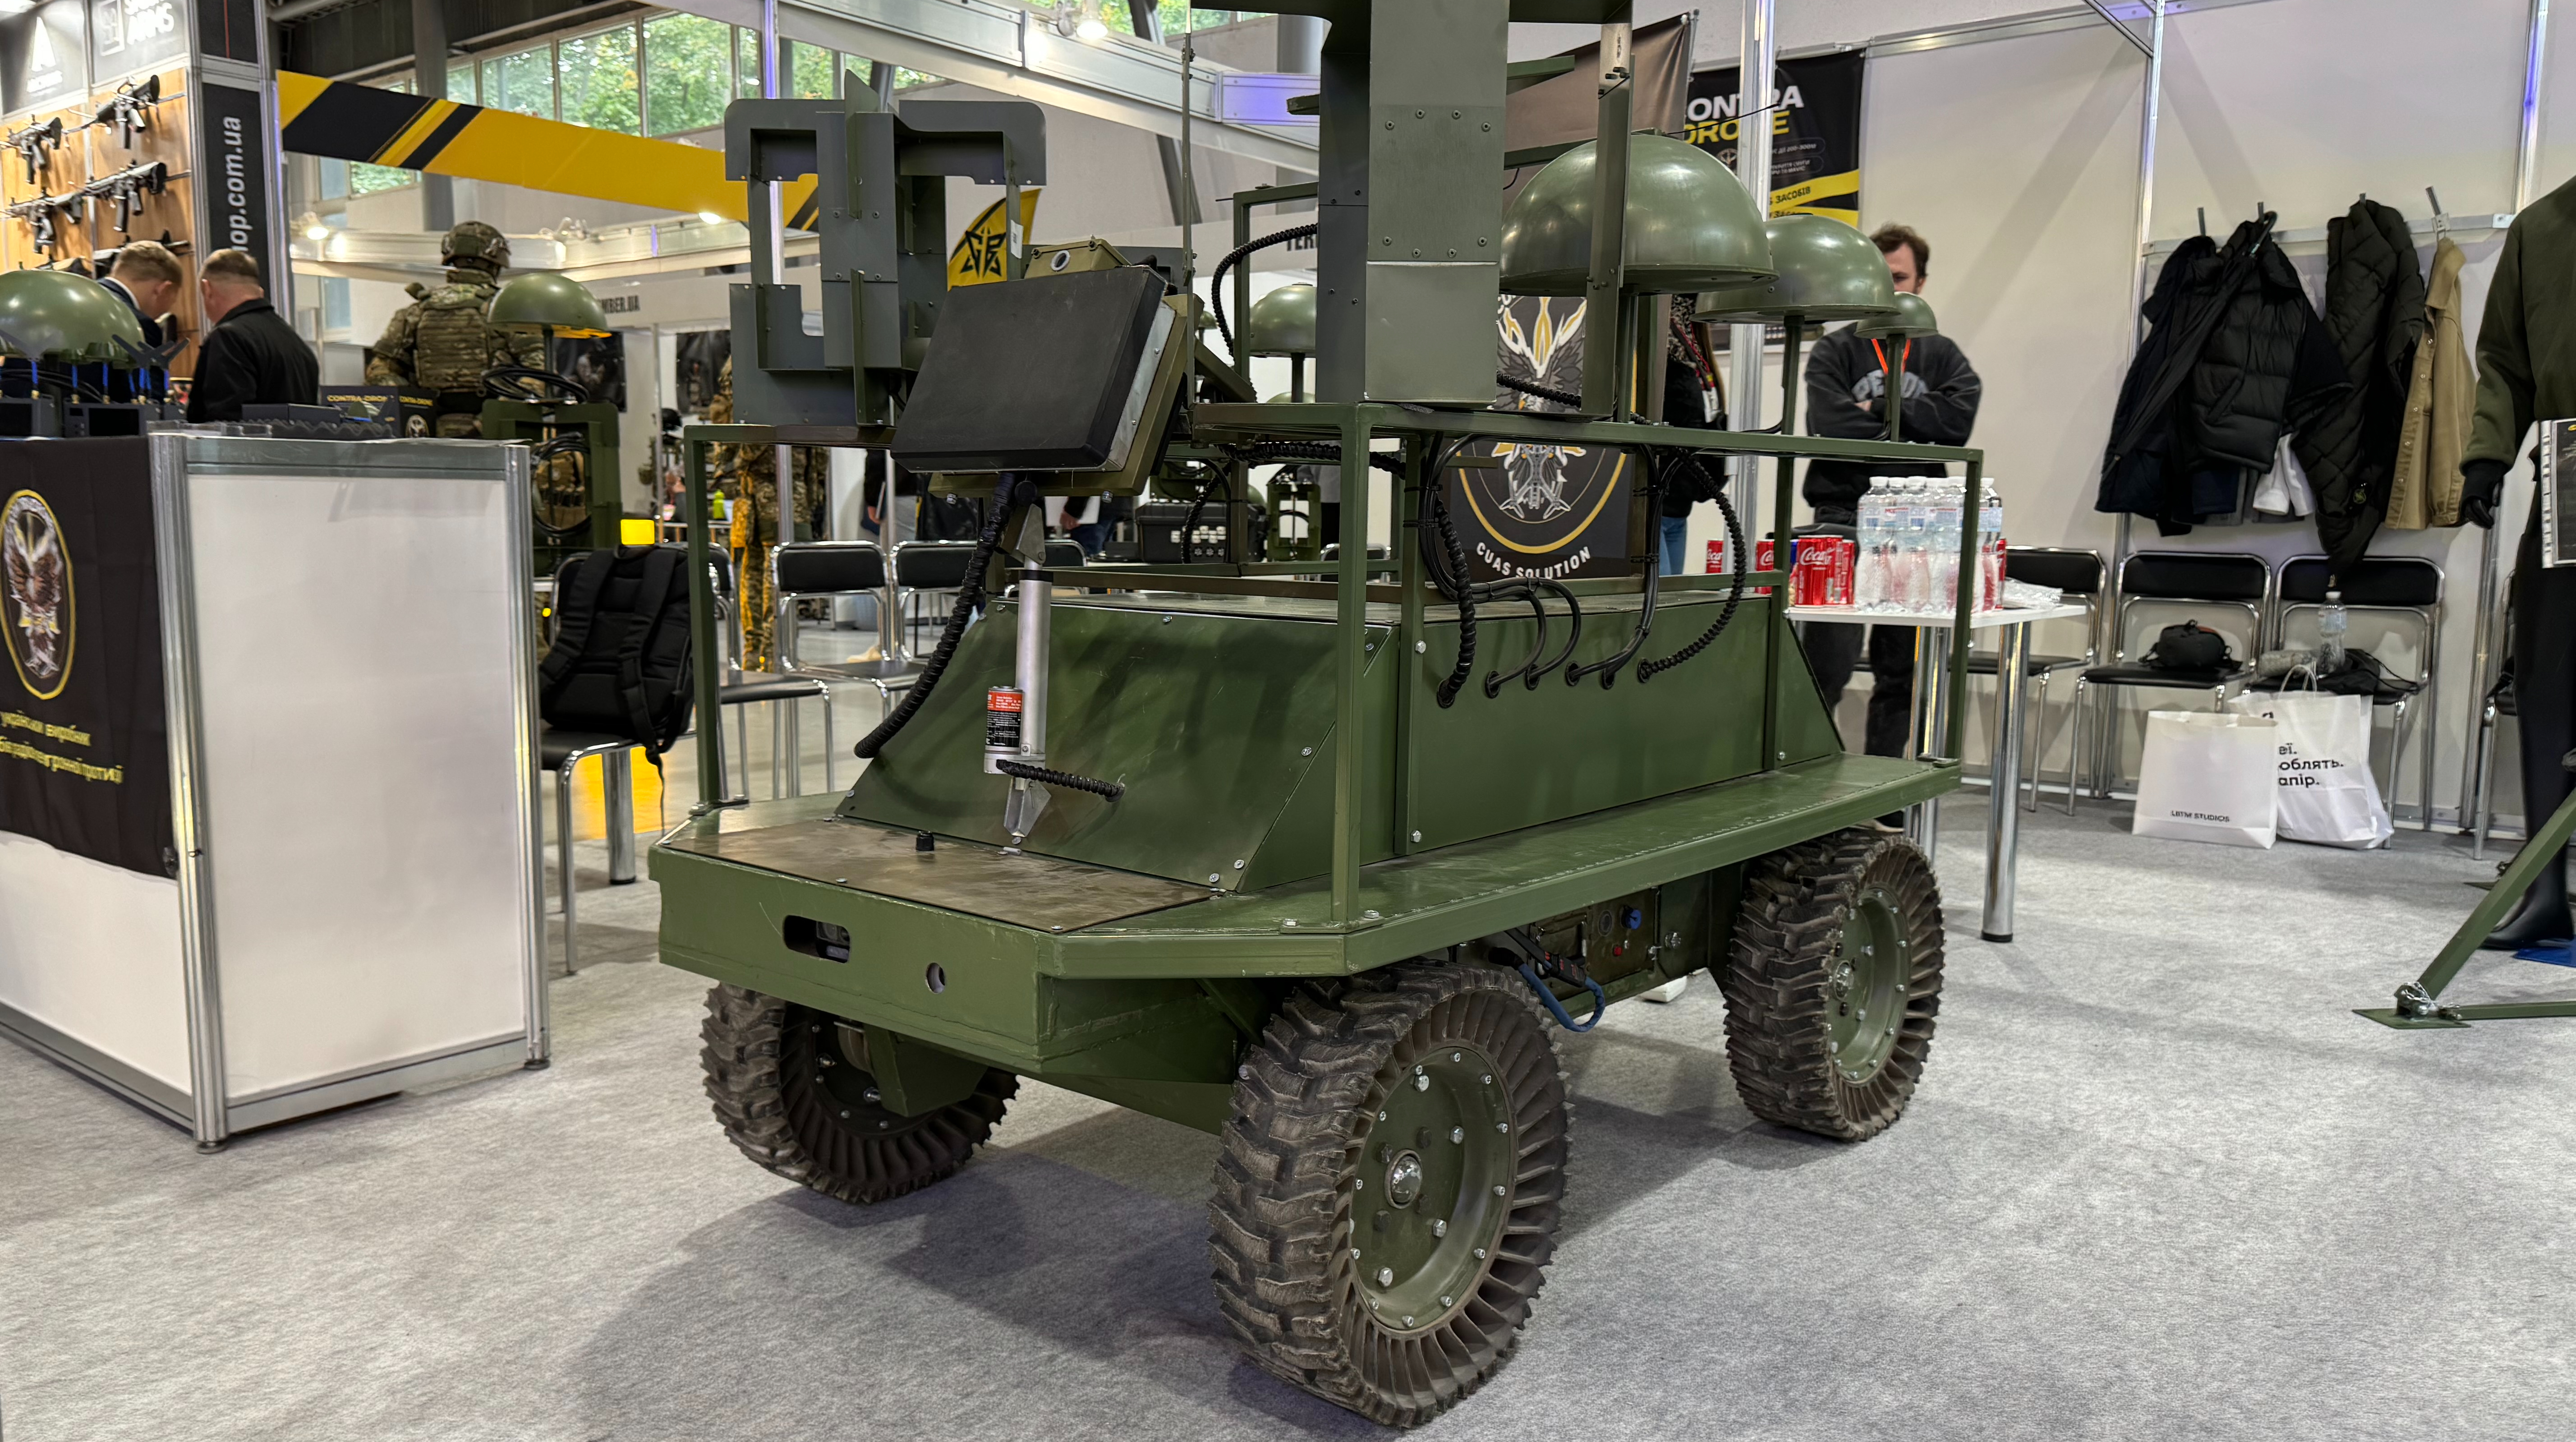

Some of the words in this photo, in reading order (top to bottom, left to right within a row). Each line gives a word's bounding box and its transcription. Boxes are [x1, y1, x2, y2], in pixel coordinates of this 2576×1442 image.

[601, 295, 640, 314] MBER.UA
[1476, 542, 1511, 576] CUAS
[1515, 546, 1591, 580] SOLUTION
[2278, 742, 2297, 755] еї.
[2278, 758, 2344, 770] облять.
[2278, 774, 2320, 788] апір.
